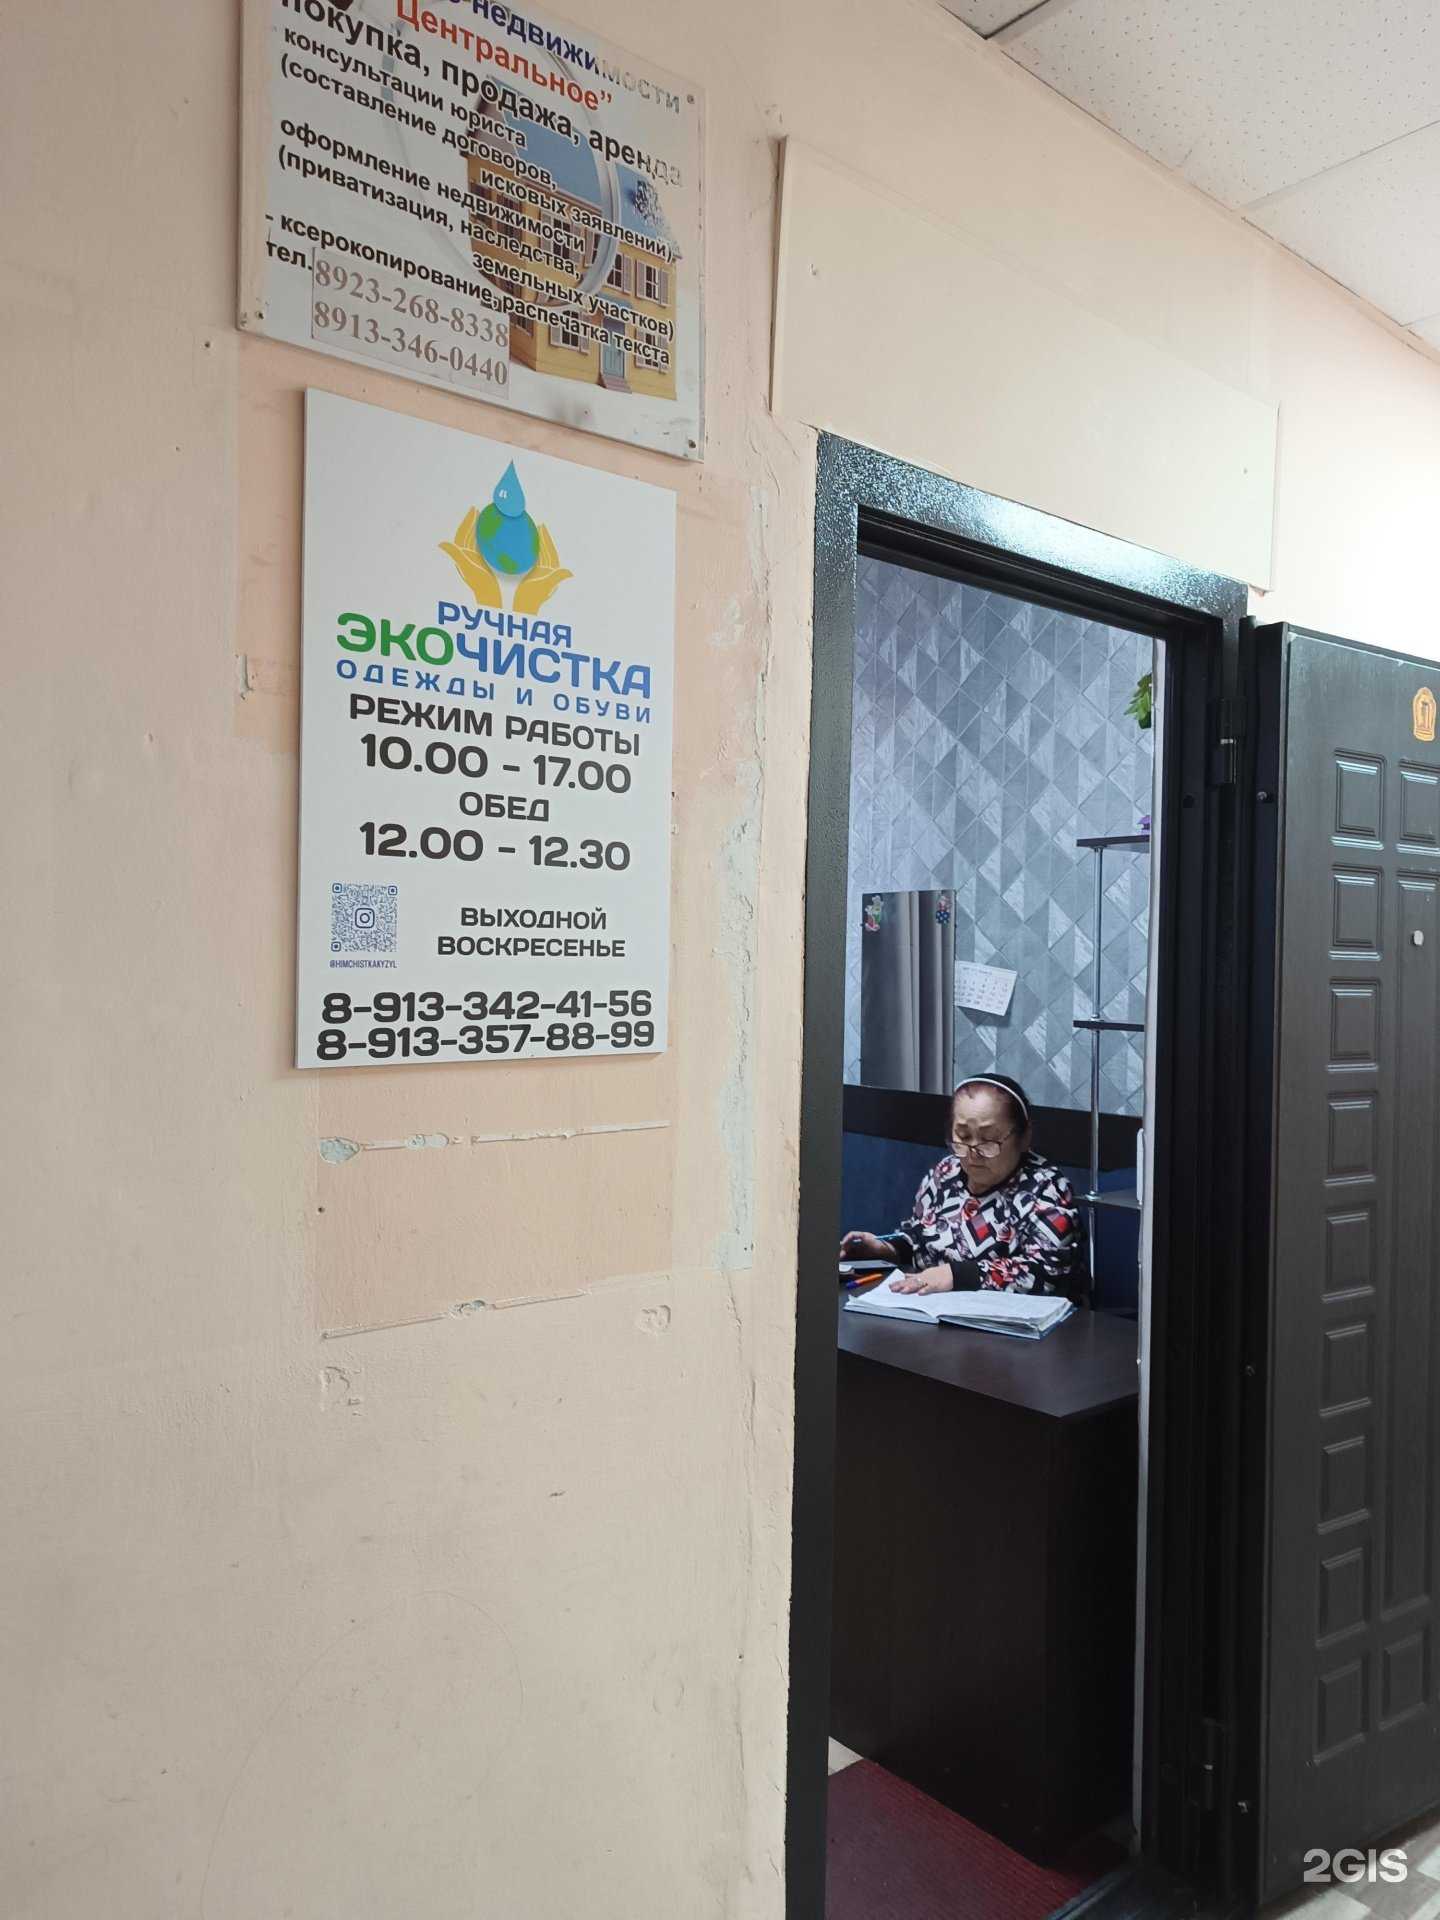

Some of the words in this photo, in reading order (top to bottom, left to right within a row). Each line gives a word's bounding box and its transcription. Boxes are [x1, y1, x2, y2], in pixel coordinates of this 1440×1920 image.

[285, 28, 443, 111] консультации
[451, 102, 526, 147] юриста
[442, 60, 578, 145] продажа,
[281, 53, 436, 136] (составление
[442, 129, 557, 189] договоров,
[277, 144, 454, 233] (приватизация,
[460, 219, 580, 280] наследства,
[280, 119, 431, 191] оформление
[437, 182, 586, 252] недвижимости
[480, 170, 567, 217] исковых
[571, 205, 673, 262] заявлений)
[266, 241, 312, 270] тел.
[315, 259, 509, 348] 8923-268-8338
[473, 252, 583, 305] земельных
[588, 297, 674, 341] участков)
[314, 301, 508, 386] 8913-346-0440
[503, 297, 609, 344] распечатка
[614, 334, 669, 365] текста
[336, 612, 652, 699] ЭКОЧИСТКА
[438, 601, 572, 648] РУЧНАЯ
[336, 659, 495, 700] ОДЕЖДЫ
[516, 687, 533, 706] И
[553, 693, 651, 724] ОБУВИ
[350, 693, 493, 737] РЕЖИМ
[505, 715, 640, 756] РАБОТЫ
[360, 733, 488, 778] 10.00
[532, 754, 631, 793] 17.00
[459, 791, 550, 822] ОБЕД
[359, 821, 484, 862] 12.00
[528, 835, 631, 870] 12.30
[437, 936, 626, 958] ВОСКРЕСЕНЬЕ
[460, 907, 607, 930] ВЫХОДНОЙ
[321, 989, 652, 1024] 8-913-342-41-56
[316, 1020, 655, 1061] 8-913-357-88-99
